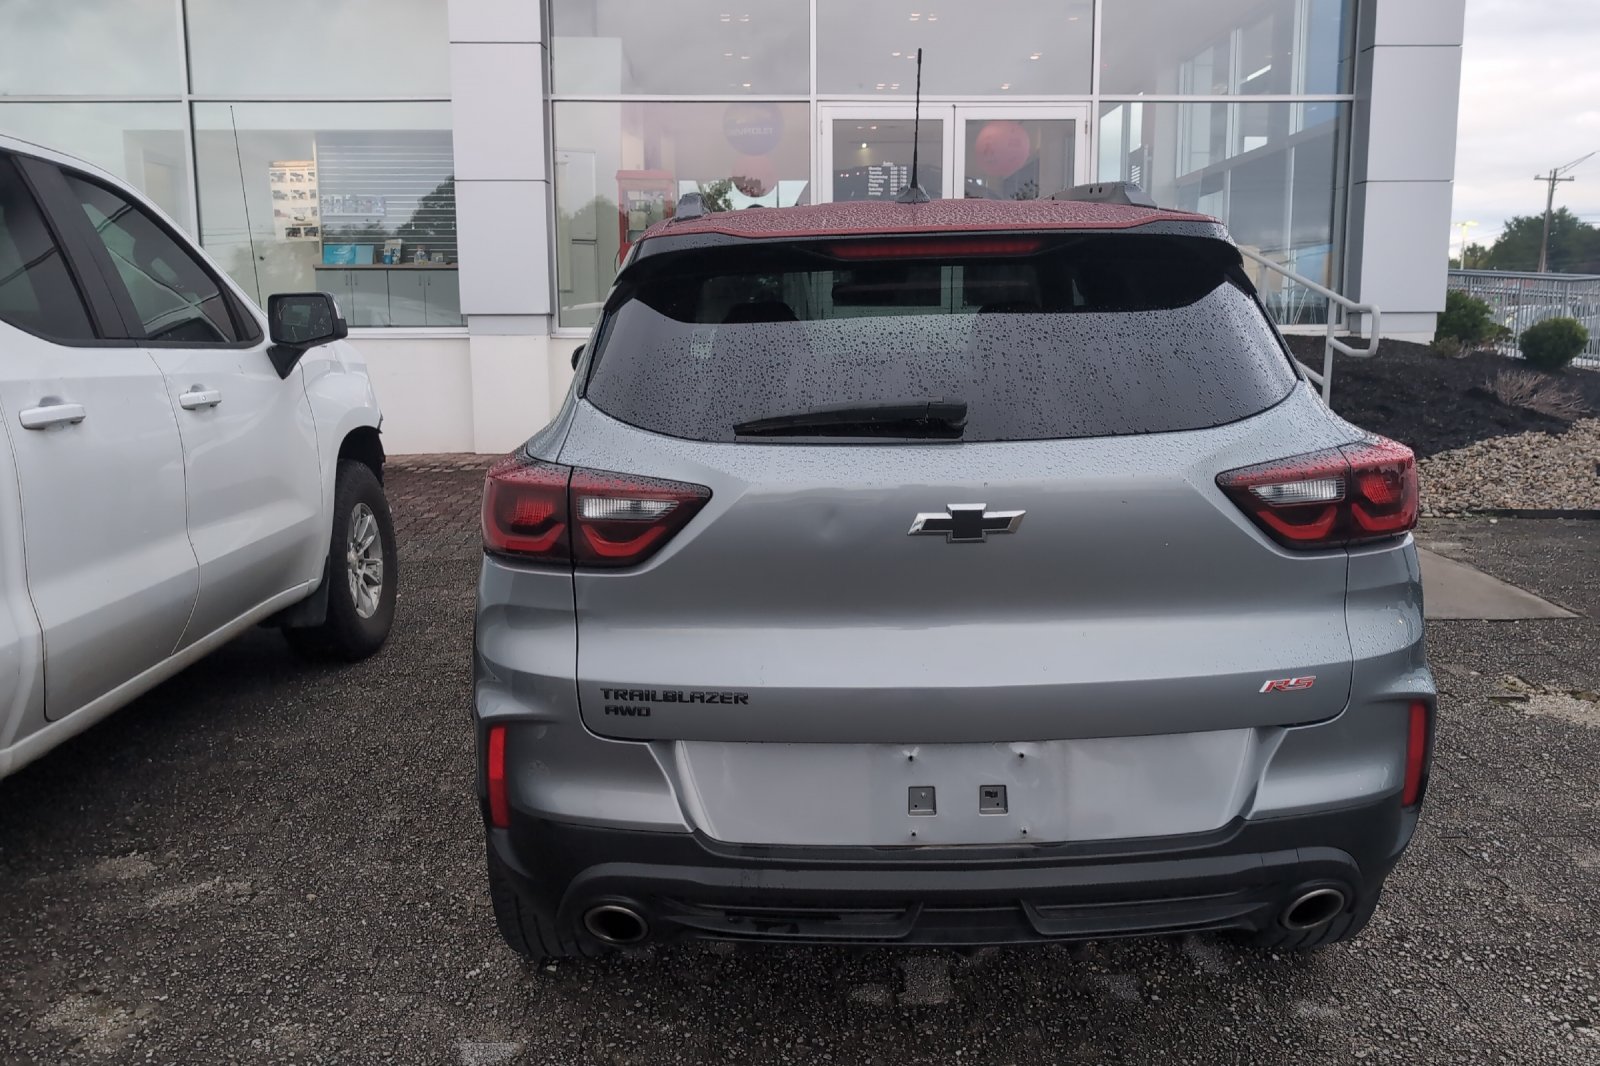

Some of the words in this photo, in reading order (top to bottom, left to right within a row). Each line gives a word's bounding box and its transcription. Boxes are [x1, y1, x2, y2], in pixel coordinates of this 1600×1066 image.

[1259, 675, 1316, 693] RS
[600, 687, 749, 705] TRAILBLAZER
[604, 704, 651, 717] AWD
